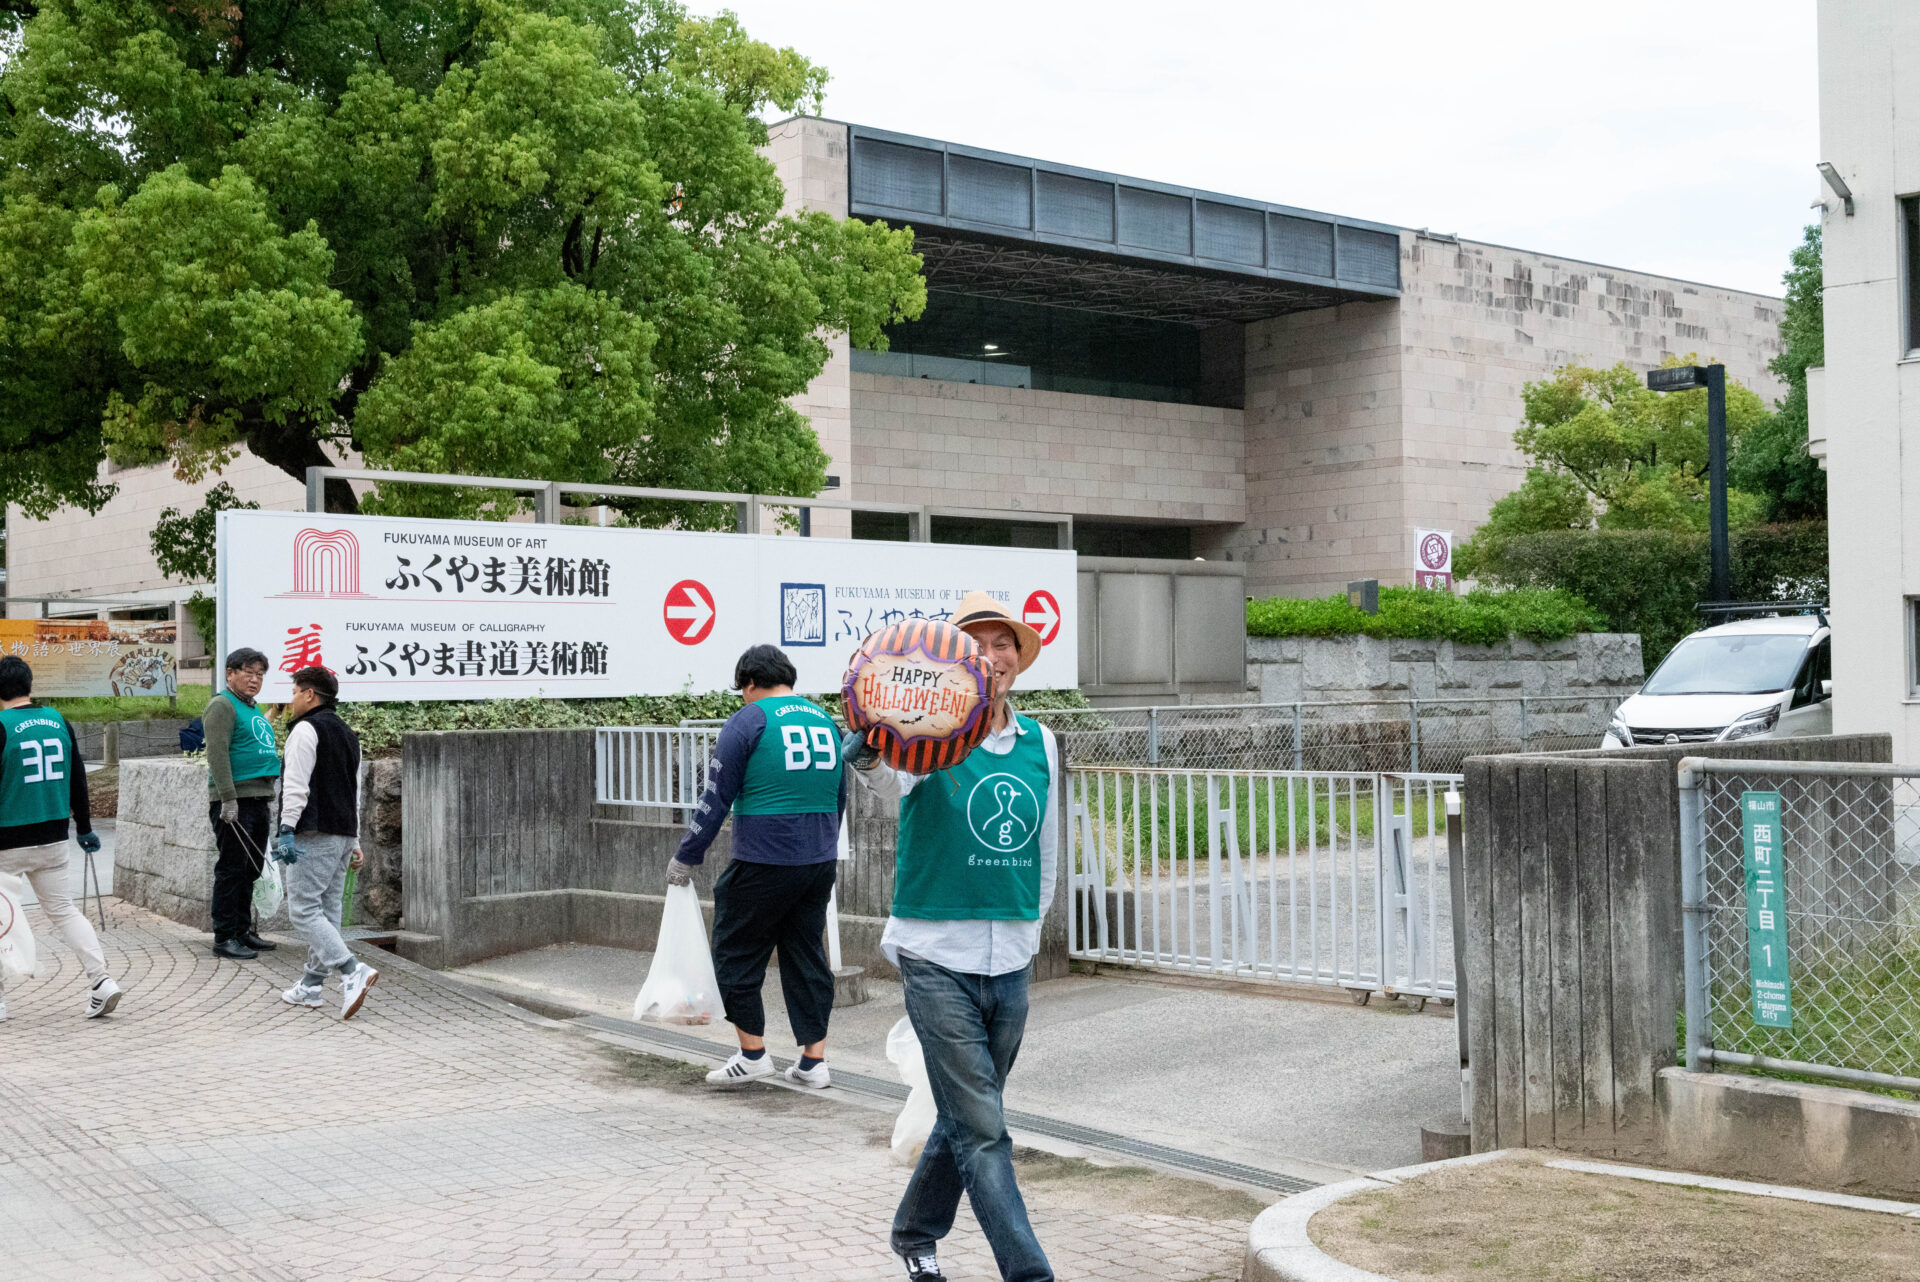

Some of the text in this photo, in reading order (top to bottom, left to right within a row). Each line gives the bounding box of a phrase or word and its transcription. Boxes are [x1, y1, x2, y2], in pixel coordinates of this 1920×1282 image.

[384, 532, 547, 549] FUKUYAMA MUSEUM OF ART
[385, 553, 610, 597] ふくやま美術館
[835, 586, 890, 599] FUKUYAMA
[895, 588, 935, 600] MUSEUM
[940, 590, 951, 600] OF
[345, 622, 546, 632] FUKUYAMA MUSEUM OF CALLIGRAPHY
[345, 640, 609, 677] ふくやま書道美術館
[891, 666, 944, 688] HAPPY
[862, 672, 971, 723] HALLOWEEN!
[775, 704, 826, 719] GREENBIRD
[14, 718, 60, 733] GREENBIRD
[780, 725, 837, 771] 89
[20, 738, 64, 783] 32
[1748, 800, 1775, 811] 福山市
[1753, 824, 1775, 968] 西町二丁目 1
[1757, 990, 1786, 1000] 2-chome
[1757, 1001, 1786, 1012] Fukuyama
[1762, 1010, 1778, 1021] City
